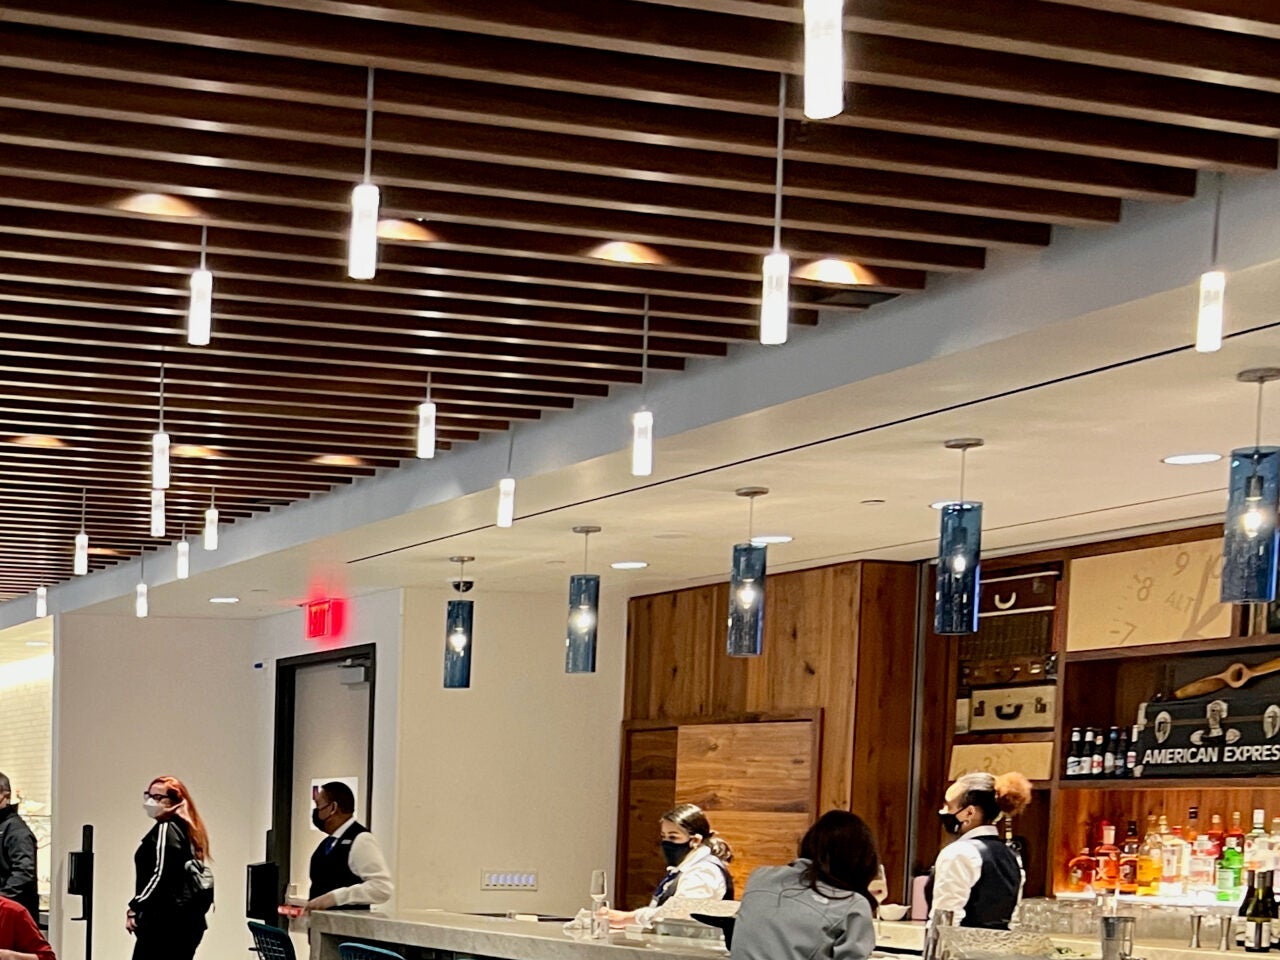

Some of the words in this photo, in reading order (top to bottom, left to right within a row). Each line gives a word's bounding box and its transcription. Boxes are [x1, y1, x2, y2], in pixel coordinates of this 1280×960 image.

[1173, 551, 1189, 576] 9
[1137, 577, 1153, 602] 8
[1164, 590, 1195, 614] ALT
[1120, 622, 1138, 645] 7
[1142, 746, 1219, 764] AMERICAN
